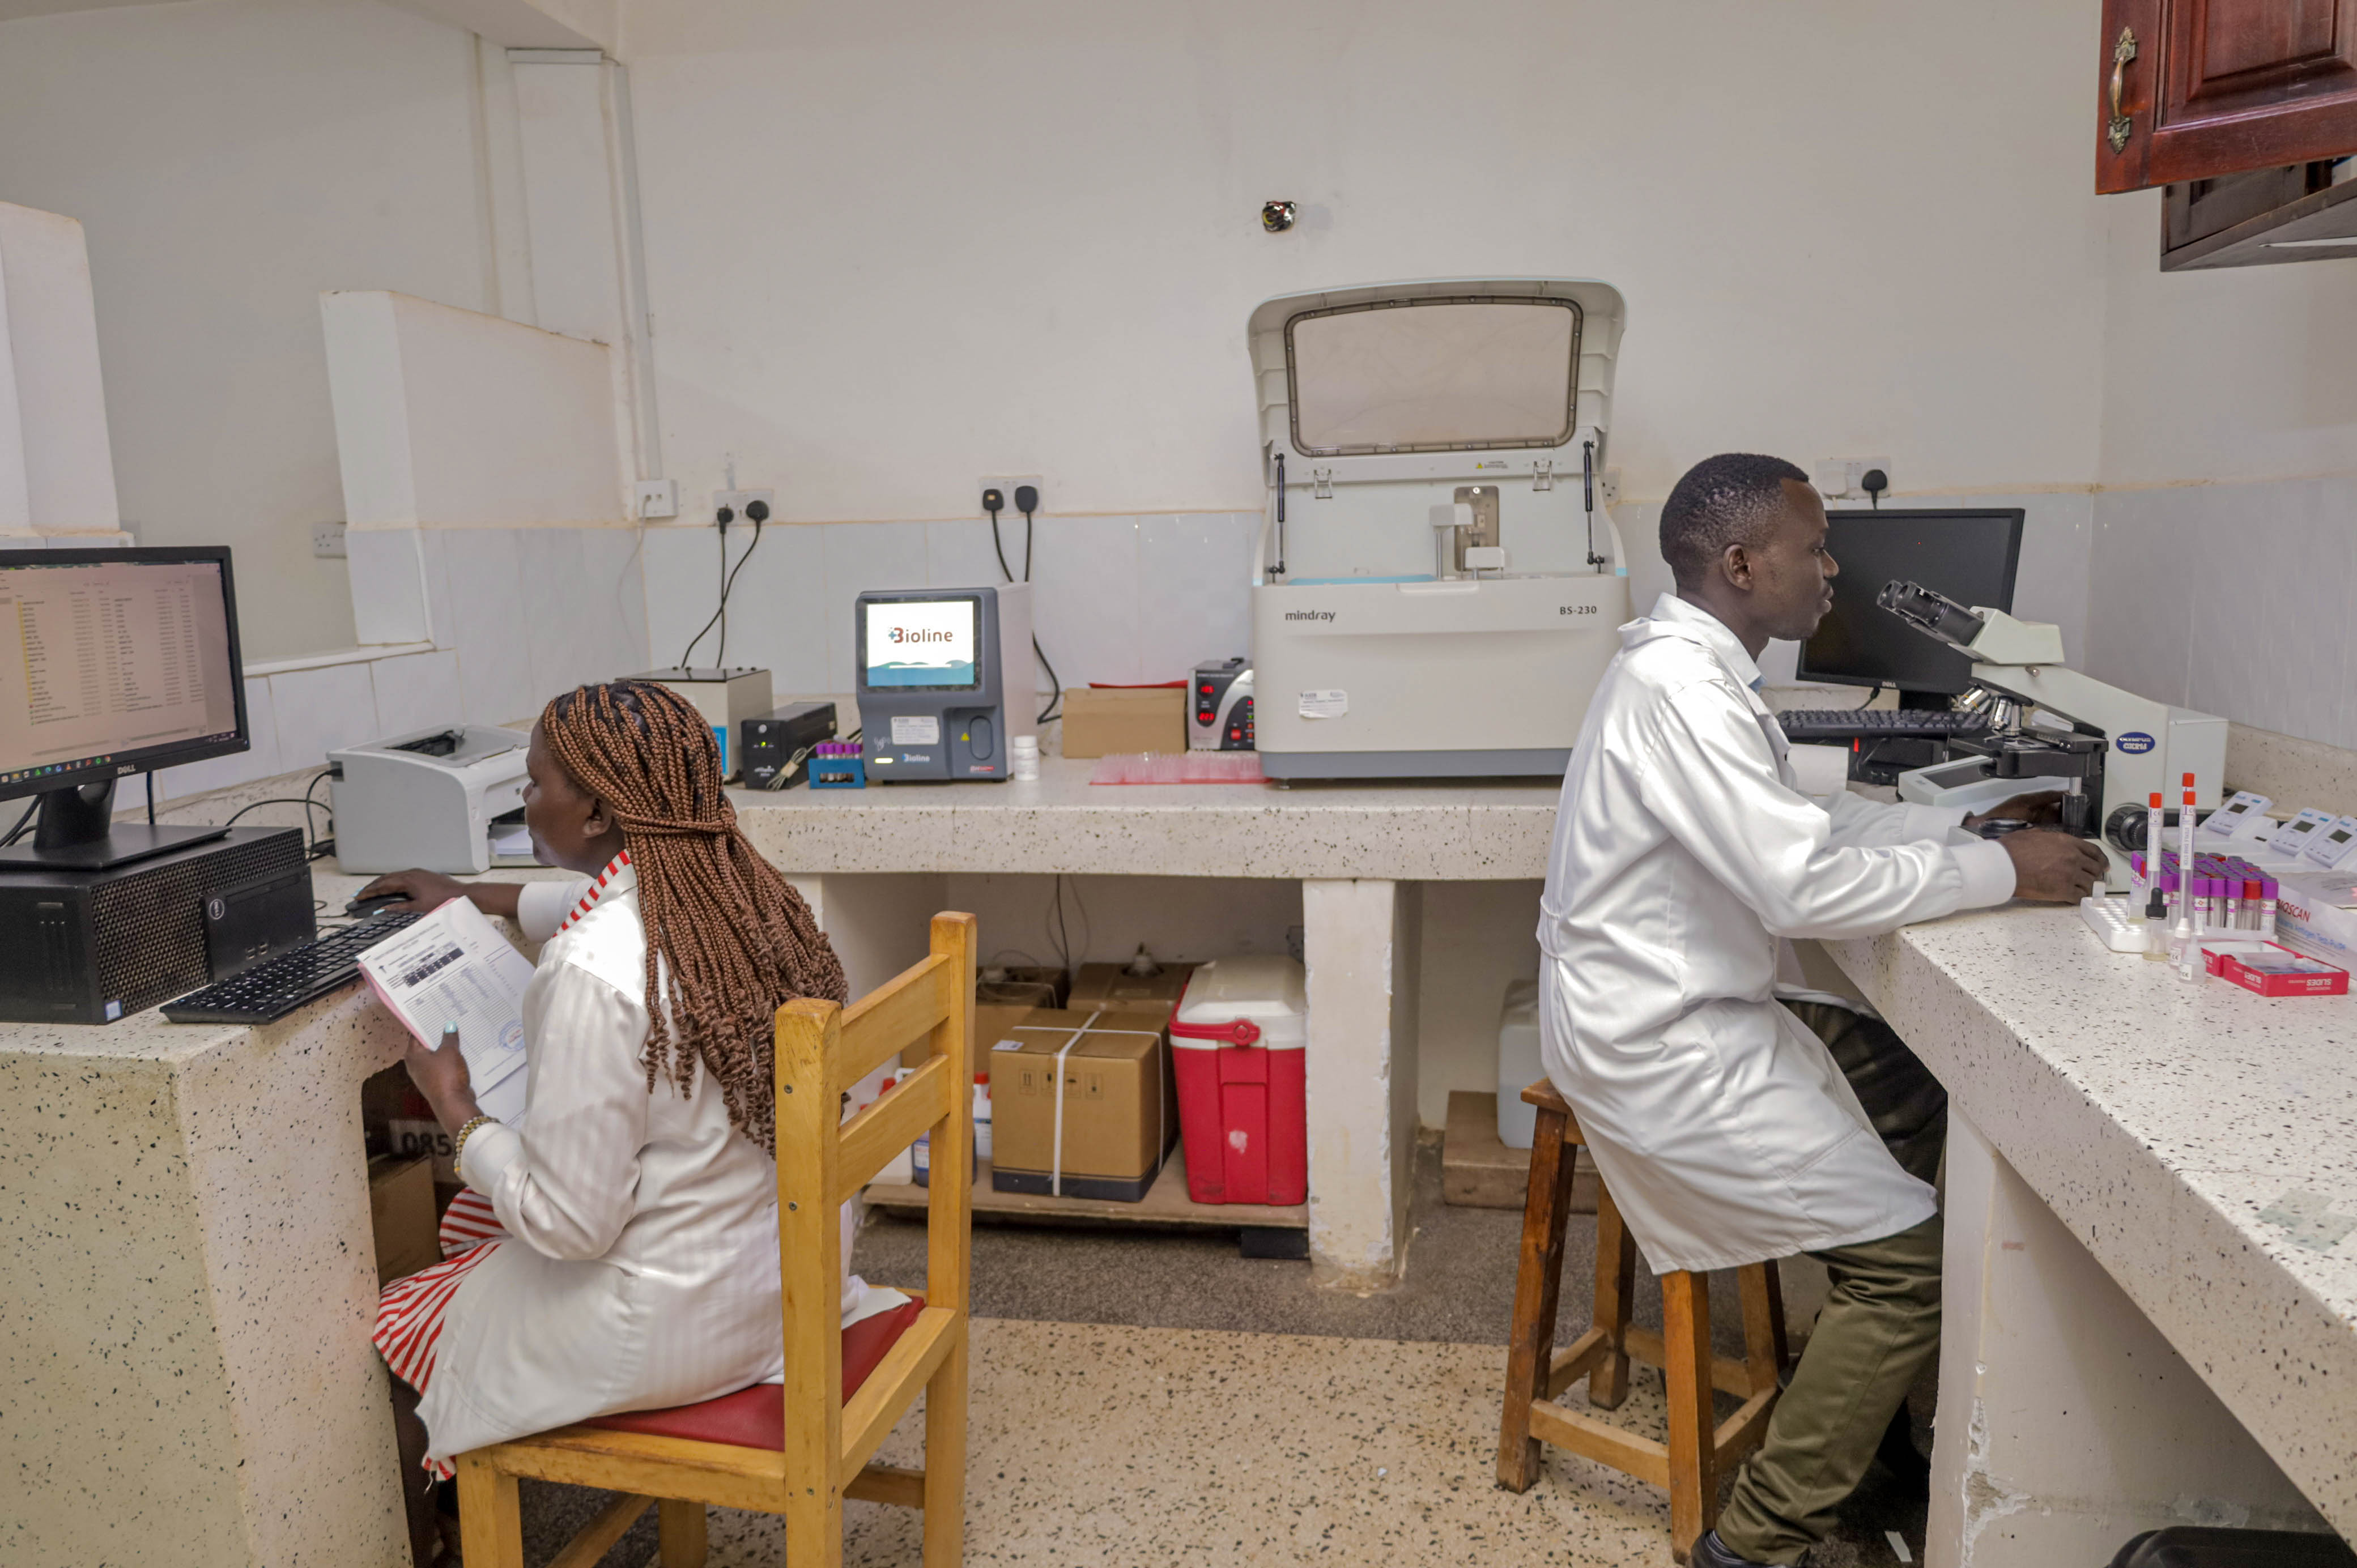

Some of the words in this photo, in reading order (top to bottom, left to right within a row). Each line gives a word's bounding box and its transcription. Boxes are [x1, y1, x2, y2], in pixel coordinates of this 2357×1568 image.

[1285, 610, 1336, 623] mindray
[1559, 606, 1597, 615] BS-230
[894, 627, 953, 644] Bioline
[117, 764, 136, 775] DELL
[2276, 898, 2311, 922] BIOSCAN
